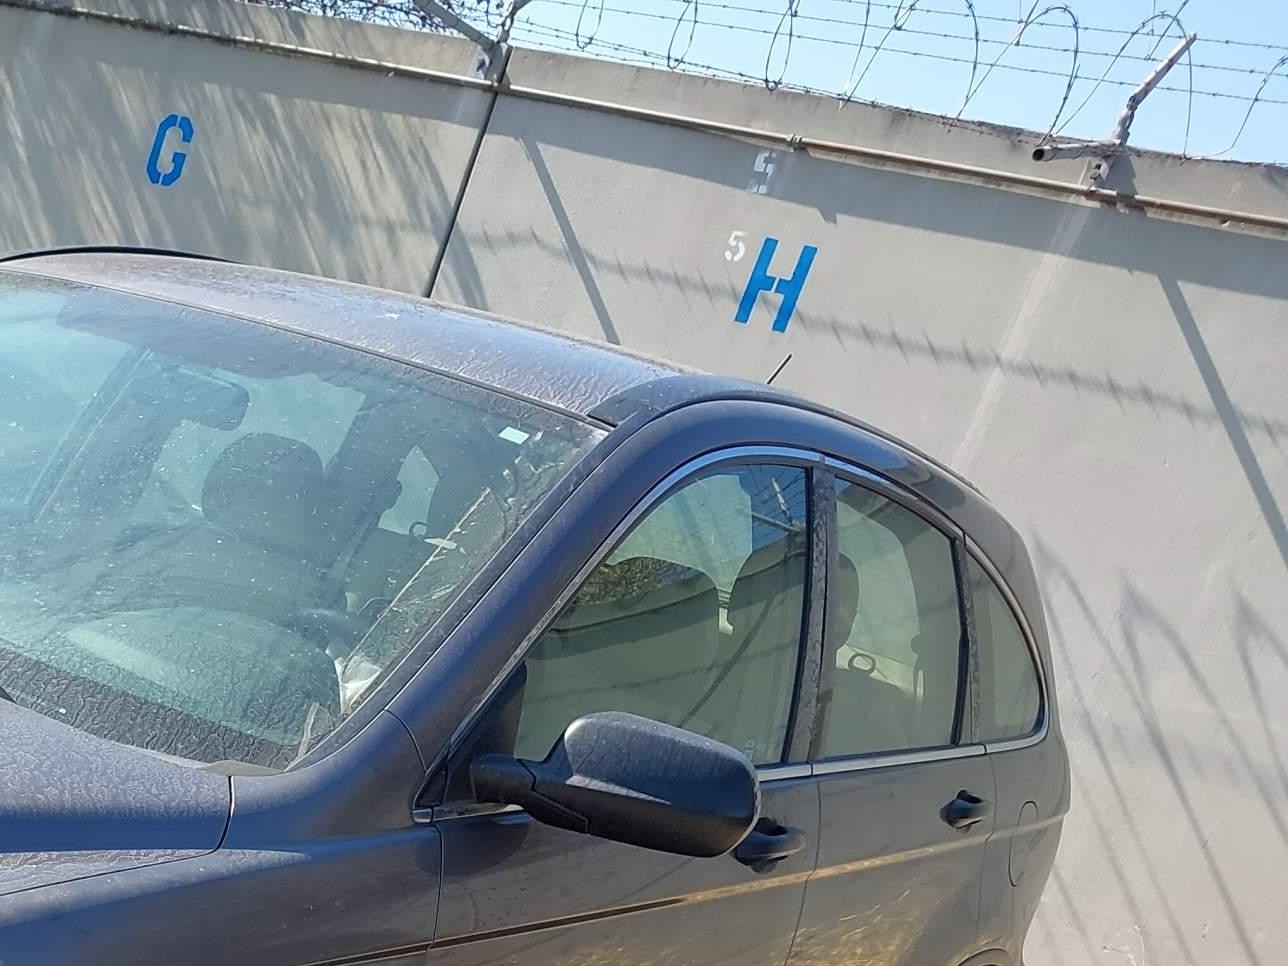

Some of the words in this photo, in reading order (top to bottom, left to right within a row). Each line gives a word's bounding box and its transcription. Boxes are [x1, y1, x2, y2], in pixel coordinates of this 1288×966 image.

[145, 113, 195, 187] G
[724, 230, 747, 262] 5
[734, 236, 819, 333] H
